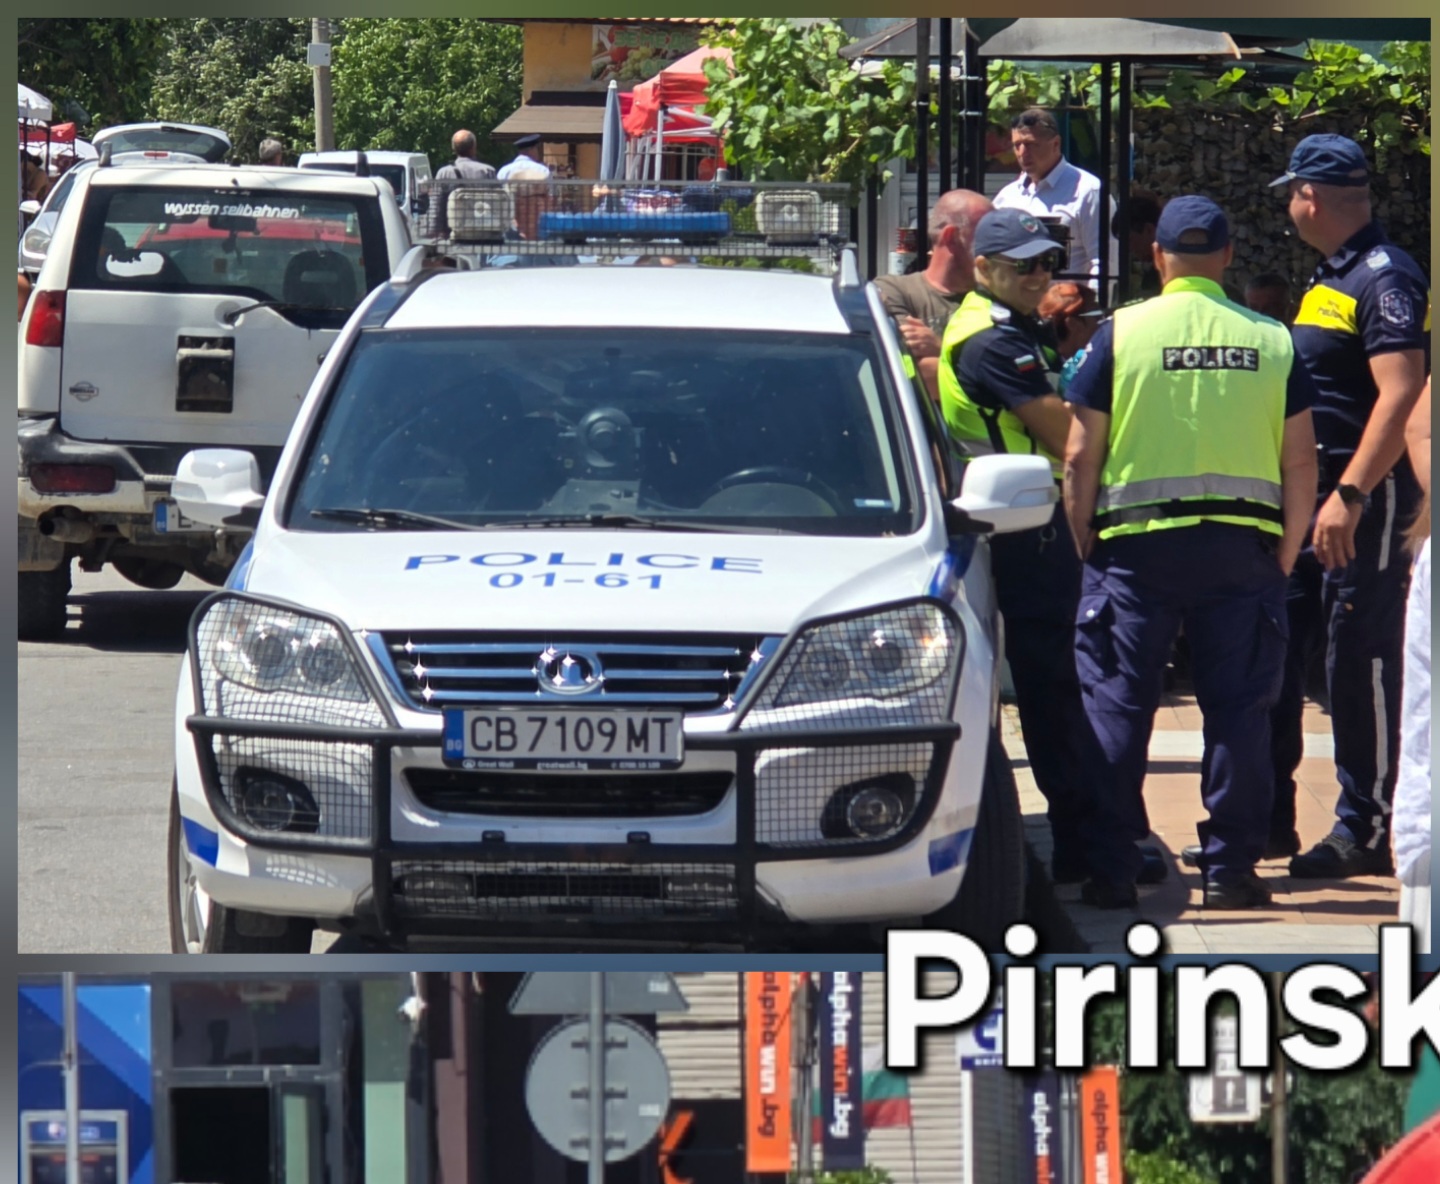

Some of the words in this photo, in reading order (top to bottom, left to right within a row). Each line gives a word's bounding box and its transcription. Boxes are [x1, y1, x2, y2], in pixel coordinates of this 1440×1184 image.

[164, 202, 220, 216] wyssen
[1165, 347, 1257, 369] POLICE
[404, 552, 763, 574] POLICE
[489, 572, 662, 590] 01-61
[470, 716, 518, 752] CB
[527, 716, 618, 753] 7109
[626, 717, 675, 753] MT
